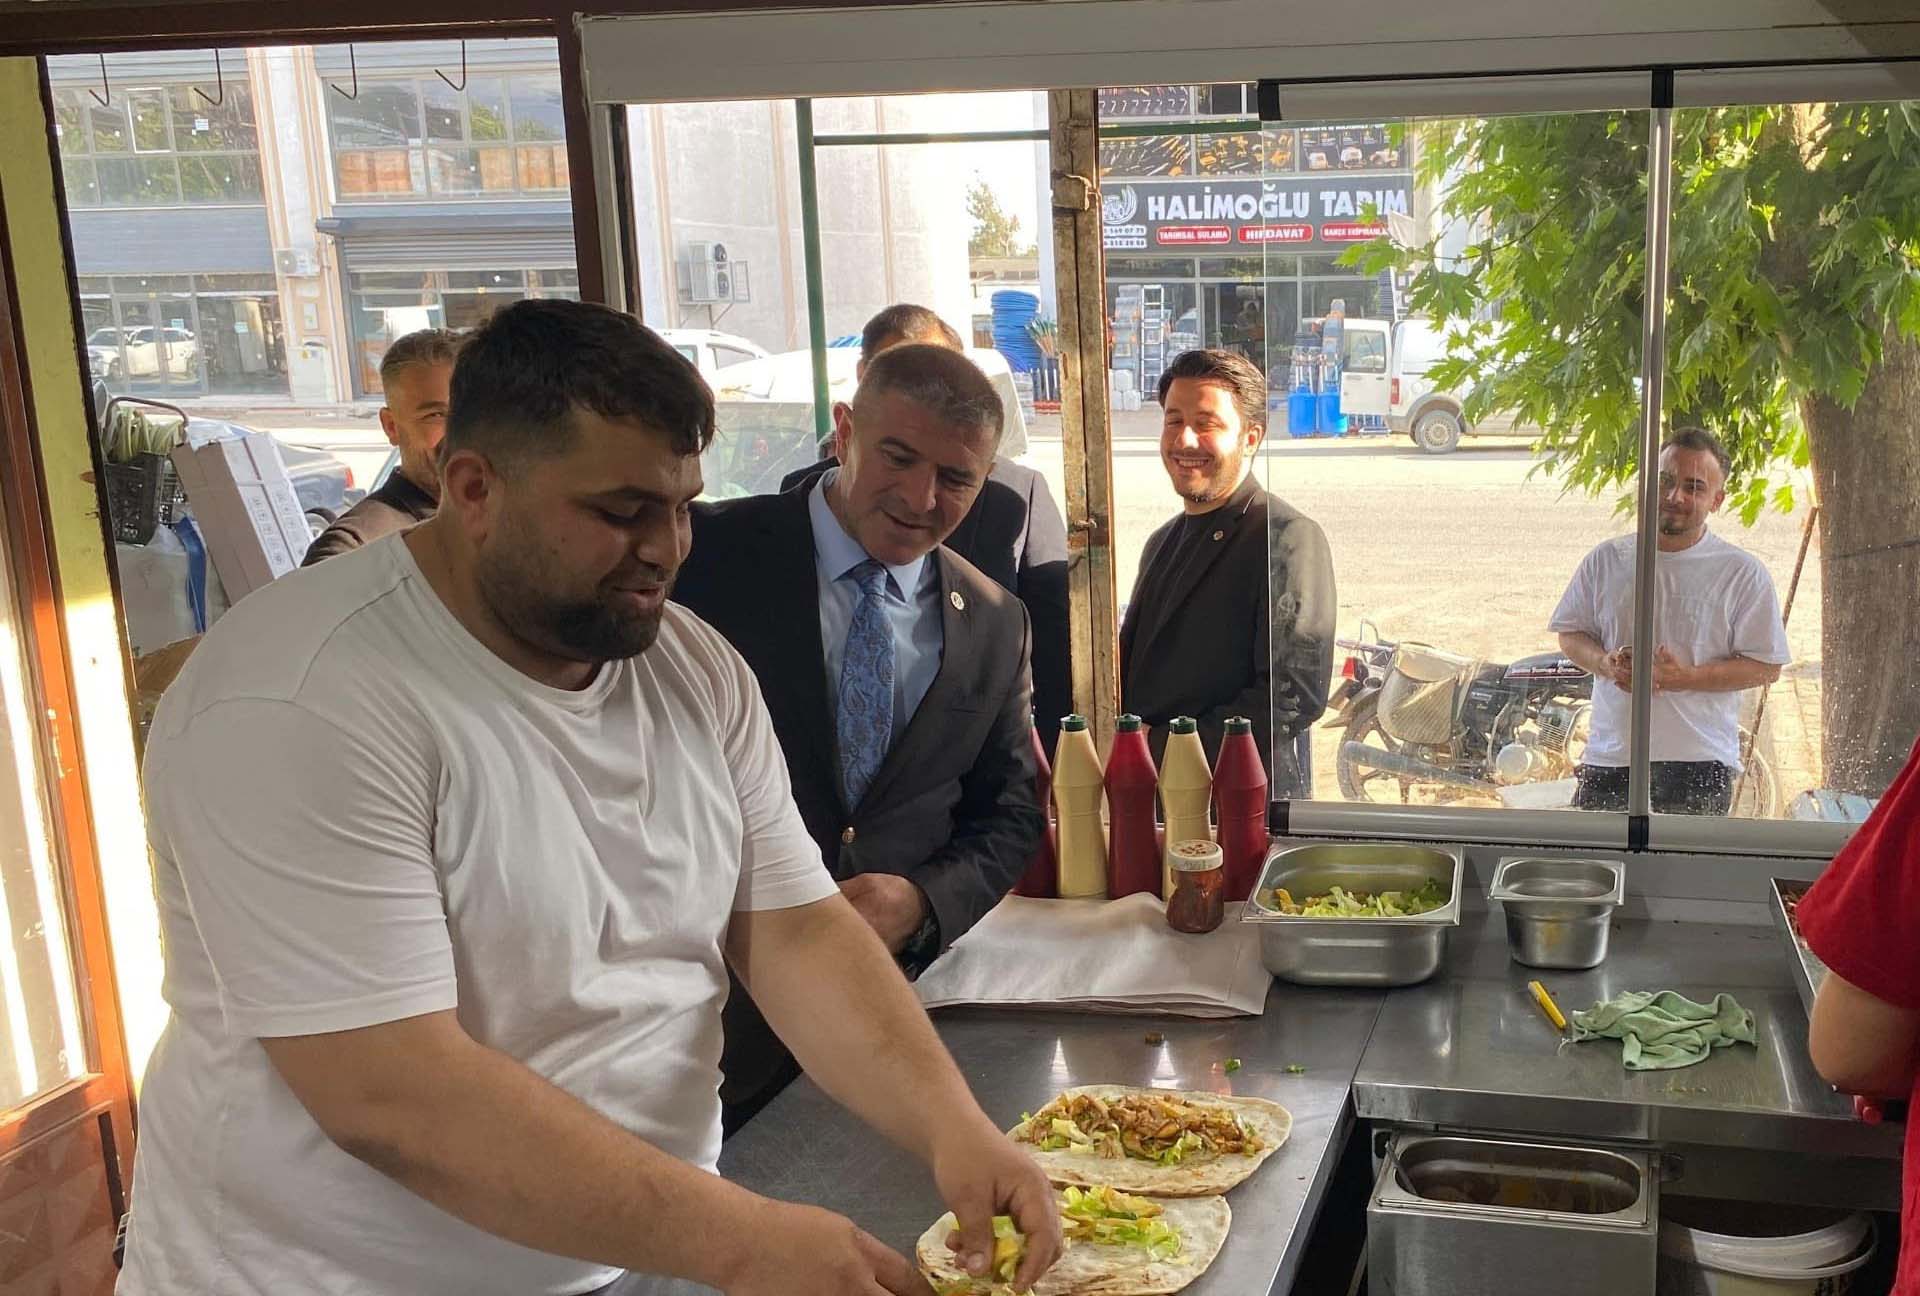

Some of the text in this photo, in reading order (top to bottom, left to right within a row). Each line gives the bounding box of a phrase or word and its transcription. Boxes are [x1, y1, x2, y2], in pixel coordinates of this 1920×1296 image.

[1148, 184, 1408, 221] HALİMOĞLU TARIM
[1246, 228, 1305, 240] HIRDAVAT
